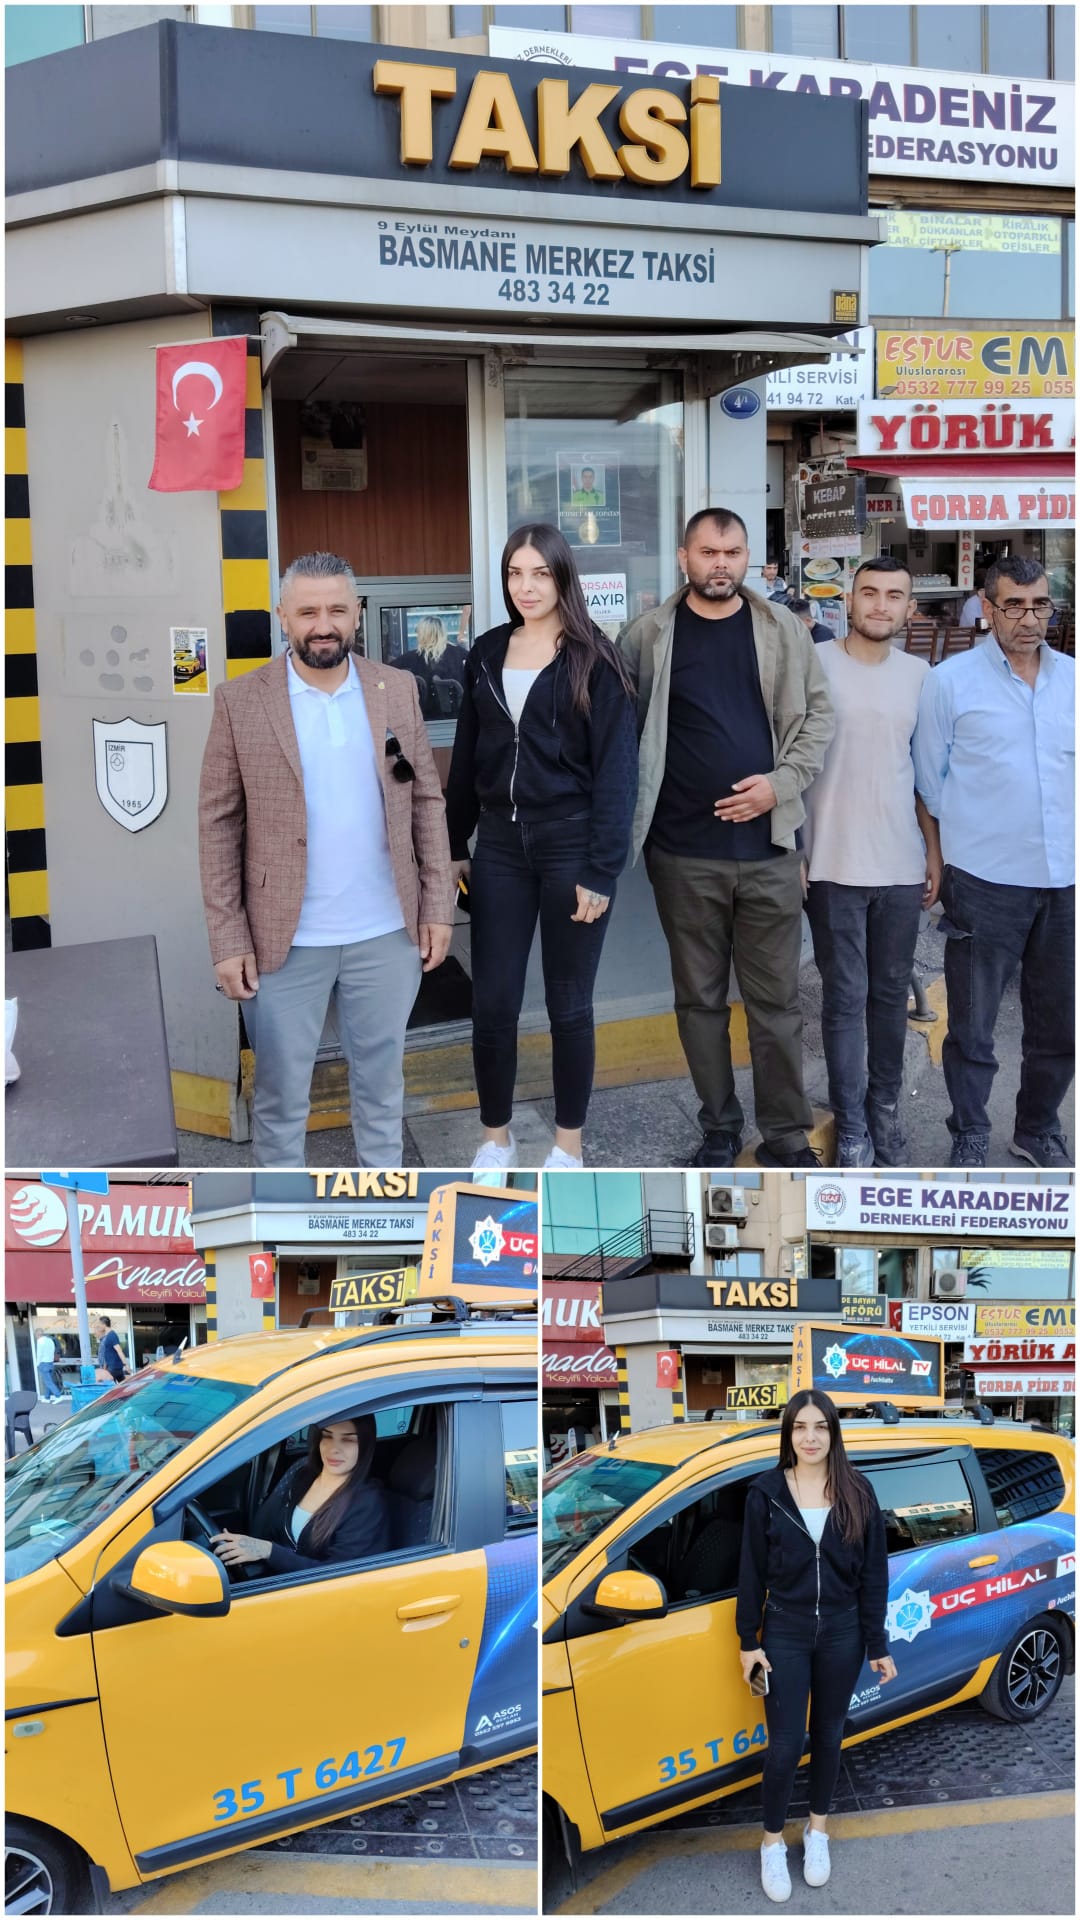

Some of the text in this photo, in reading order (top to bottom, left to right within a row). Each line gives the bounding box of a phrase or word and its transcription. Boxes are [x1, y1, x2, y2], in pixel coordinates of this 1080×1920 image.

[372, 59, 722, 189] TAKSİ
[868, 133, 1058, 170] DERASYONU
[377, 221, 516, 240] 9 Eylül Meydanı
[378, 234, 715, 284] BASMANE MERKEZ TAKSİ
[498, 278, 610, 306] 483 34 22
[796, 368, 858, 385] SERVİSİ
[896, 366, 966, 376] Uluslararası
[896, 380, 940, 395] 0532
[946, 380, 978, 394] 777
[984, 380, 1005, 394] 99
[1011, 380, 1031, 394] 25
[787, 392, 804, 405] 94
[807, 392, 823, 405] 72
[871, 403, 1054, 451] YÖRÜK
[813, 485, 846, 504] KEBAP
[911, 494, 1010, 527] ÇORBA
[122, 799, 142, 809] 1965
[860, 1186, 913, 1208] EGE
[921, 1187, 1070, 1213] KARADENİZ
[308, 1216, 414, 1230] BASMANE MERKEZ TAKSİ
[860, 1212, 1069, 1230] DERNEKLERİ FEDERASYONU
[342, 1230, 379, 1238] 483 34 22
[332, 1270, 405, 1307] TAKSİ
[706, 1277, 799, 1308] TAKSİ
[908, 1305, 969, 1321] EPSON
[707, 1323, 797, 1333] BASMANE MERKEZ TAKS
[969, 1338, 1055, 1361] YÖRÜK
[852, 1357, 930, 1373] ÜÇ HİLAL TV
[978, 1380, 1024, 1396] ÇORBA
[1028, 1377, 1059, 1393] PİDE
[727, 1386, 778, 1407] TAKSİ
[941, 1588, 976, 1611] ÜÇ
[985, 1568, 1048, 1598] HİLAL
[493, 1704, 522, 1720] ASOS
[658, 1748, 698, 1784] 35
[704, 1737, 725, 1764] T
[212, 1736, 407, 1821] 35 T 6427
